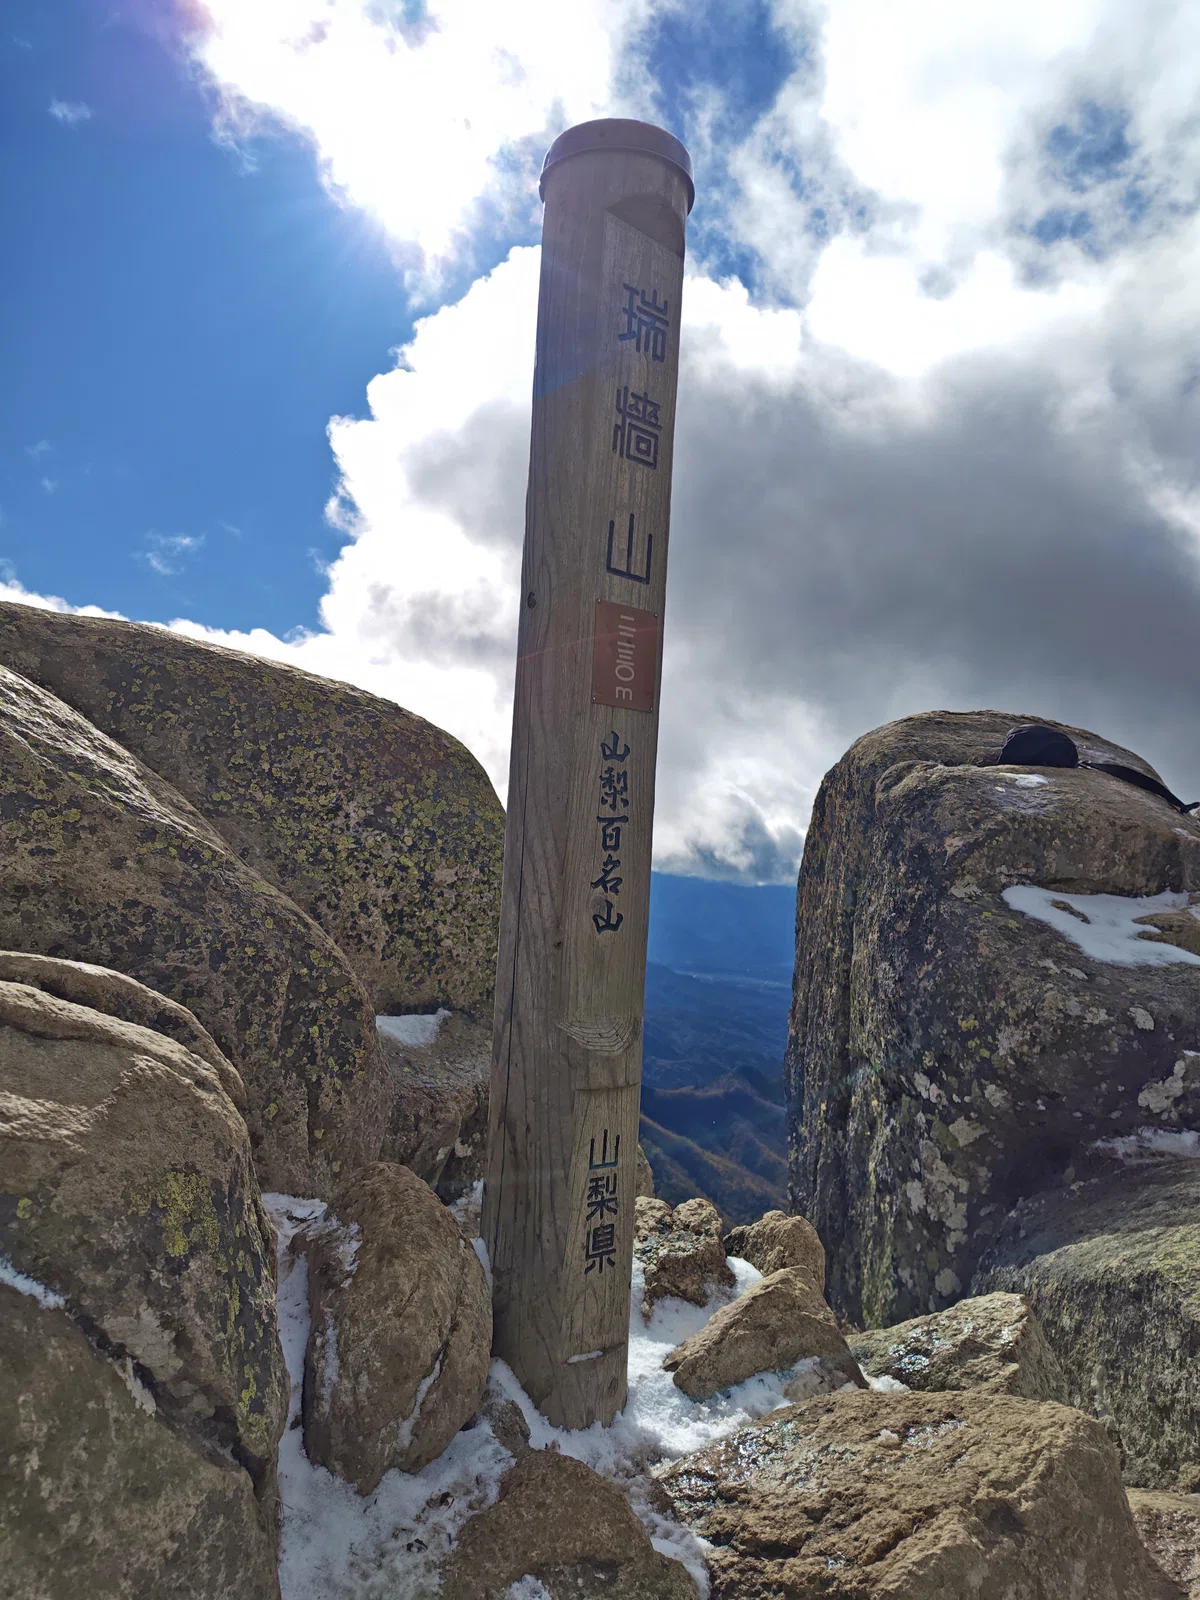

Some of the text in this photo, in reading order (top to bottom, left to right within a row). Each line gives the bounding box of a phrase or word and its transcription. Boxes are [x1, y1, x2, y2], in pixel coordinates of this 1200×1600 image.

[606, 282, 670, 583] 瑞牆山
[591, 730, 631, 934] 山梨百名山
[584, 1128, 621, 1275] 山梨県
